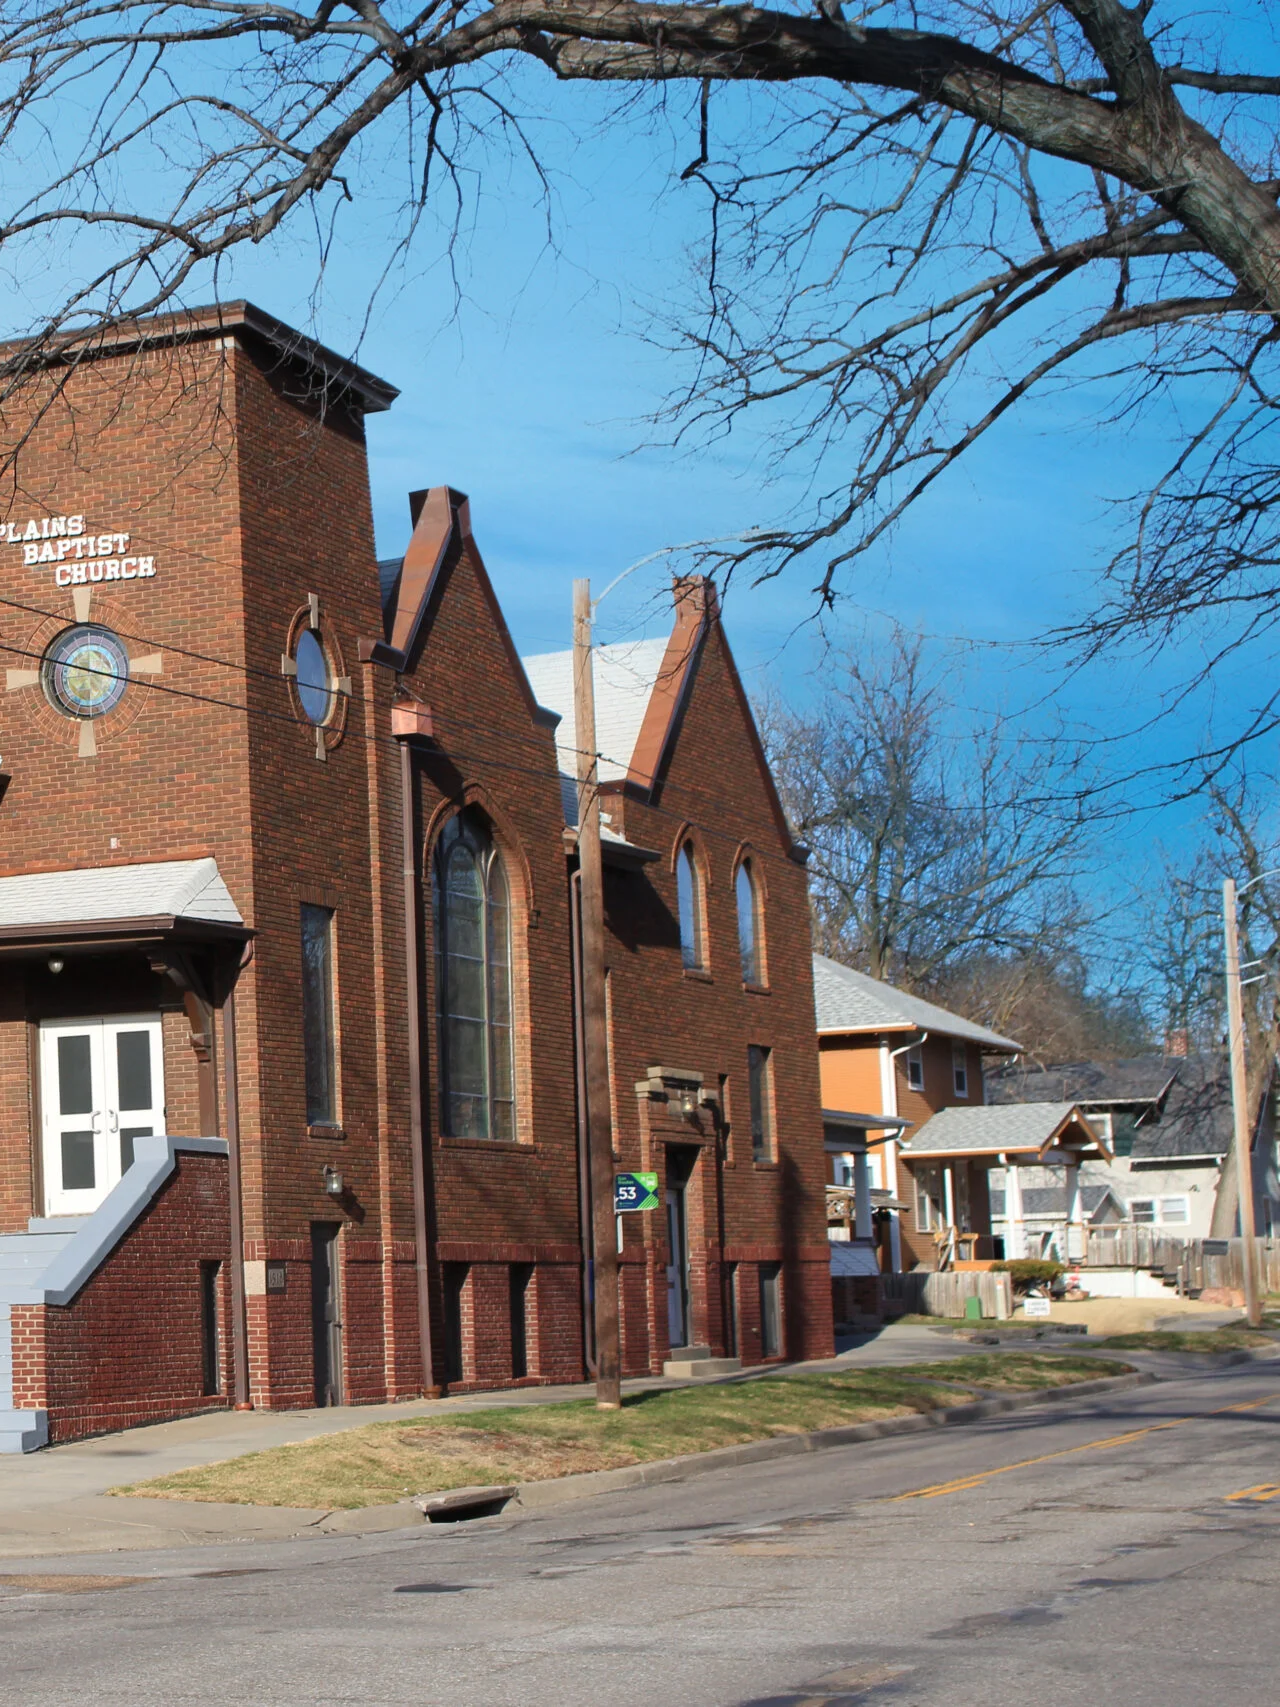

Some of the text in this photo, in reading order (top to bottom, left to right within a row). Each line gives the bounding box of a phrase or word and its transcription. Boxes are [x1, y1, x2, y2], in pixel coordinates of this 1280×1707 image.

[23, 532, 130, 565] BAPTIST
[55, 556, 156, 587] CHURCH
[619, 1186, 637, 1200] 53
